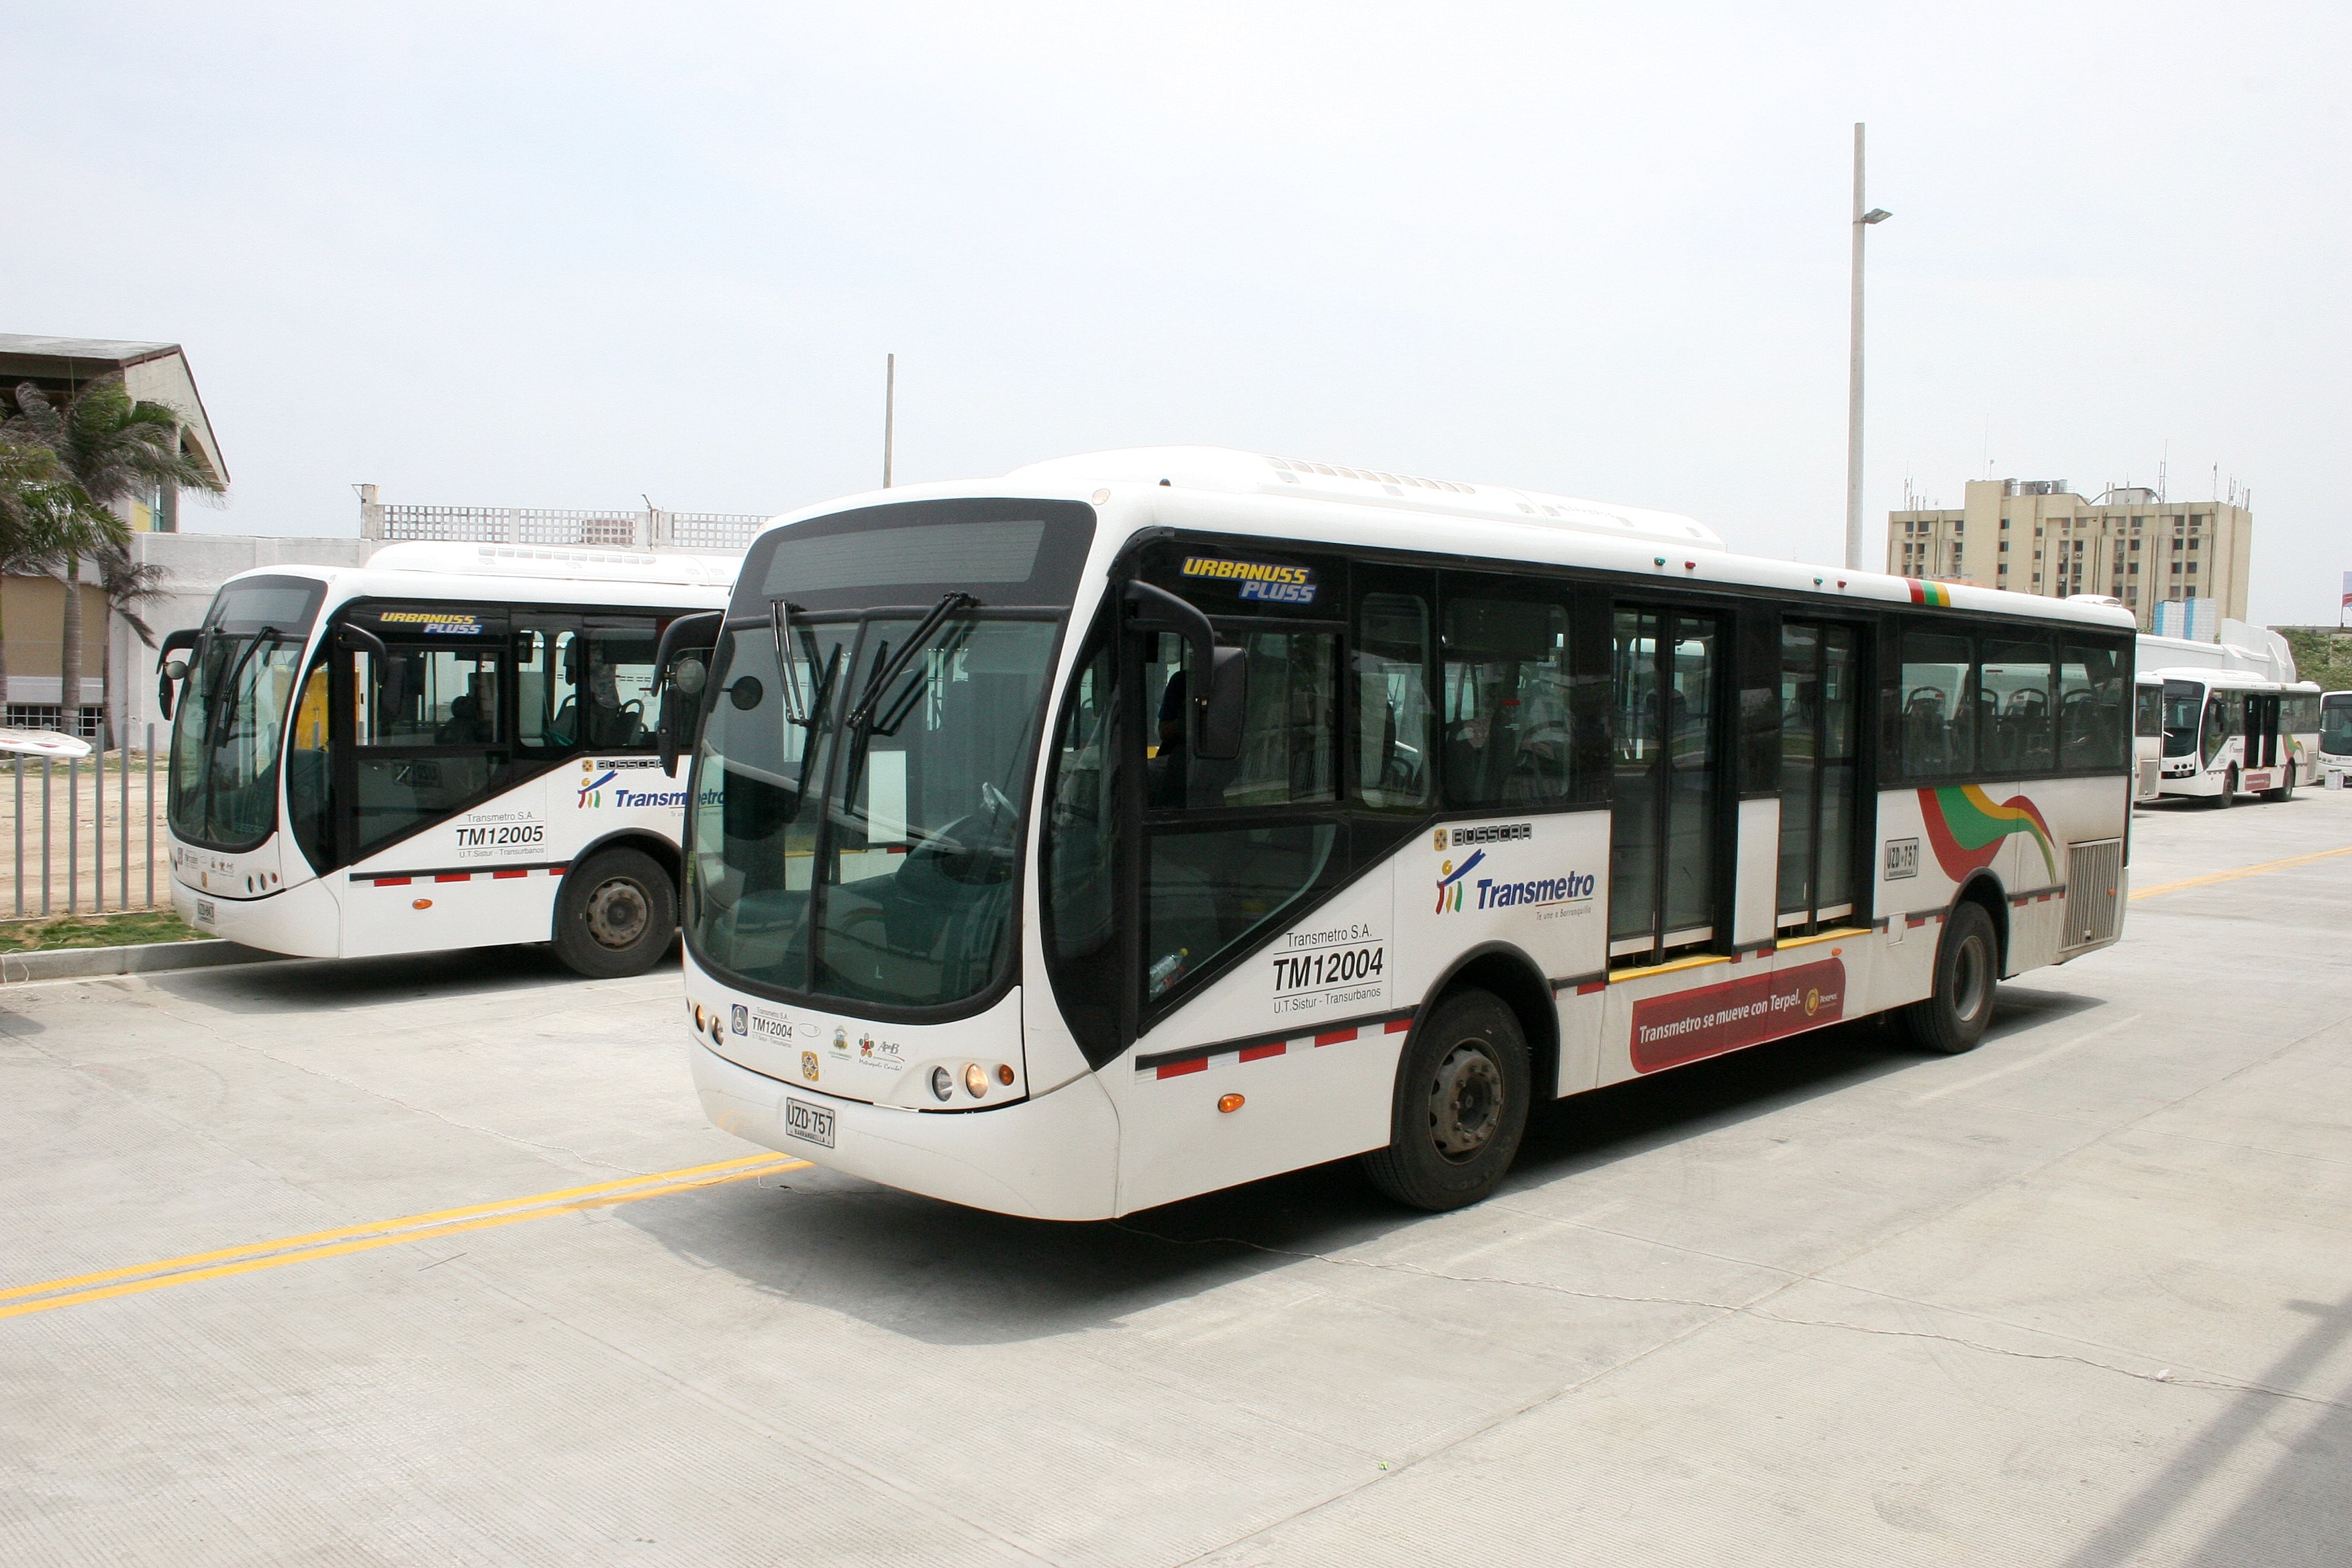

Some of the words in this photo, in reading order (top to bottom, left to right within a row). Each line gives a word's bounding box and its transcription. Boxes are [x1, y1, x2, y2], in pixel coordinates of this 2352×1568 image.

[1183, 558, 1308, 584] URBANUSS
[1242, 581, 1316, 601] PLUSS
[381, 612, 477, 624] URBANUSS
[424, 624, 483, 634] PLUSS
[467, 813, 515, 822] Transmetro
[518, 811, 535, 820] S.A.
[456, 826, 543, 846] TM12005
[1452, 823, 1532, 846] BUSSCAR
[499, 848, 545, 856] Transurbanos
[1477, 871, 1594, 910] Transmetro
[1287, 928, 1348, 947] Transmetro
[1351, 924, 1372, 938] S.A.
[1273, 947, 1383, 991] TM12004
[1325, 988, 1381, 1004] Transurbanos
[1640, 1017, 1701, 1043] Transmetro
[1703, 1014, 1714, 1028] se
[1716, 1005, 1749, 1025] mueve
[1751, 1000, 1768, 1016] con
[1771, 988, 1800, 1012] Terpel.
[752, 1016, 792, 1038] TM12004
